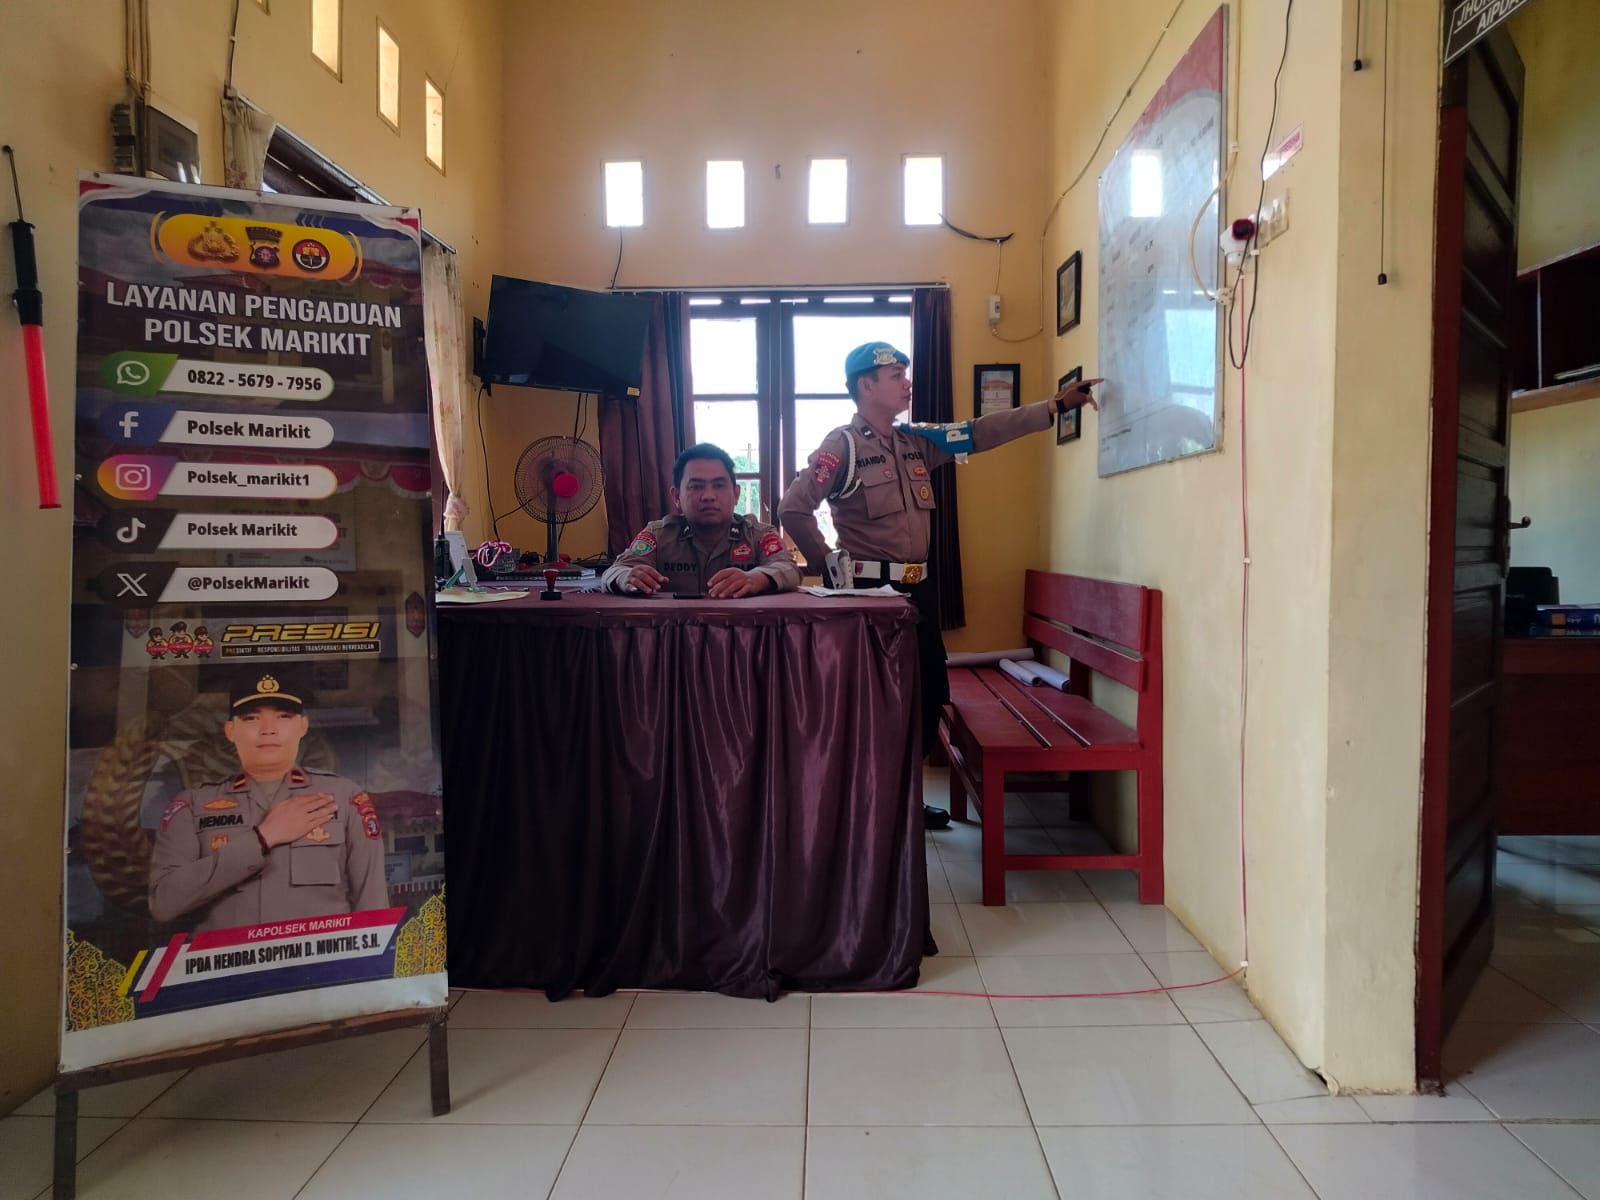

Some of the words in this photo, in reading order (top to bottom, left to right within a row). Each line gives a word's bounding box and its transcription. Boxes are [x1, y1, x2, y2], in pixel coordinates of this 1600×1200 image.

[105, 281, 237, 315] LAYANAN
[245, 295, 401, 328] PENGADUAN
[144, 318, 253, 349] POLSEK
[260, 327, 371, 356] MARIKIT
[187, 369, 225, 386] 0822
[238, 373, 274, 389] 5679
[286, 376, 322, 391] 7956
[187, 420, 245, 436] Polsek
[248, 422, 311, 439] Marikit
[187, 470, 310, 487] Polsek_marikit1
[187, 522, 239, 536] Polsek
[242, 523, 298, 537] Marikit
[187, 576, 311, 591] @PolsekMarikit
[221, 622, 381, 642] PRESISI
[199, 814, 244, 829] HENDRA
[247, 921, 307, 940] KAPOLSEK
[308, 917, 353, 932] MARIKIT
[185, 956, 211, 975] IPDA
[213, 950, 257, 970] HENDRA
[258, 944, 302, 963] SOPIYAN
[305, 942, 315, 957] D.
[316, 936, 361, 956] MUNTHE,
[362, 933, 381, 949] S.H.
